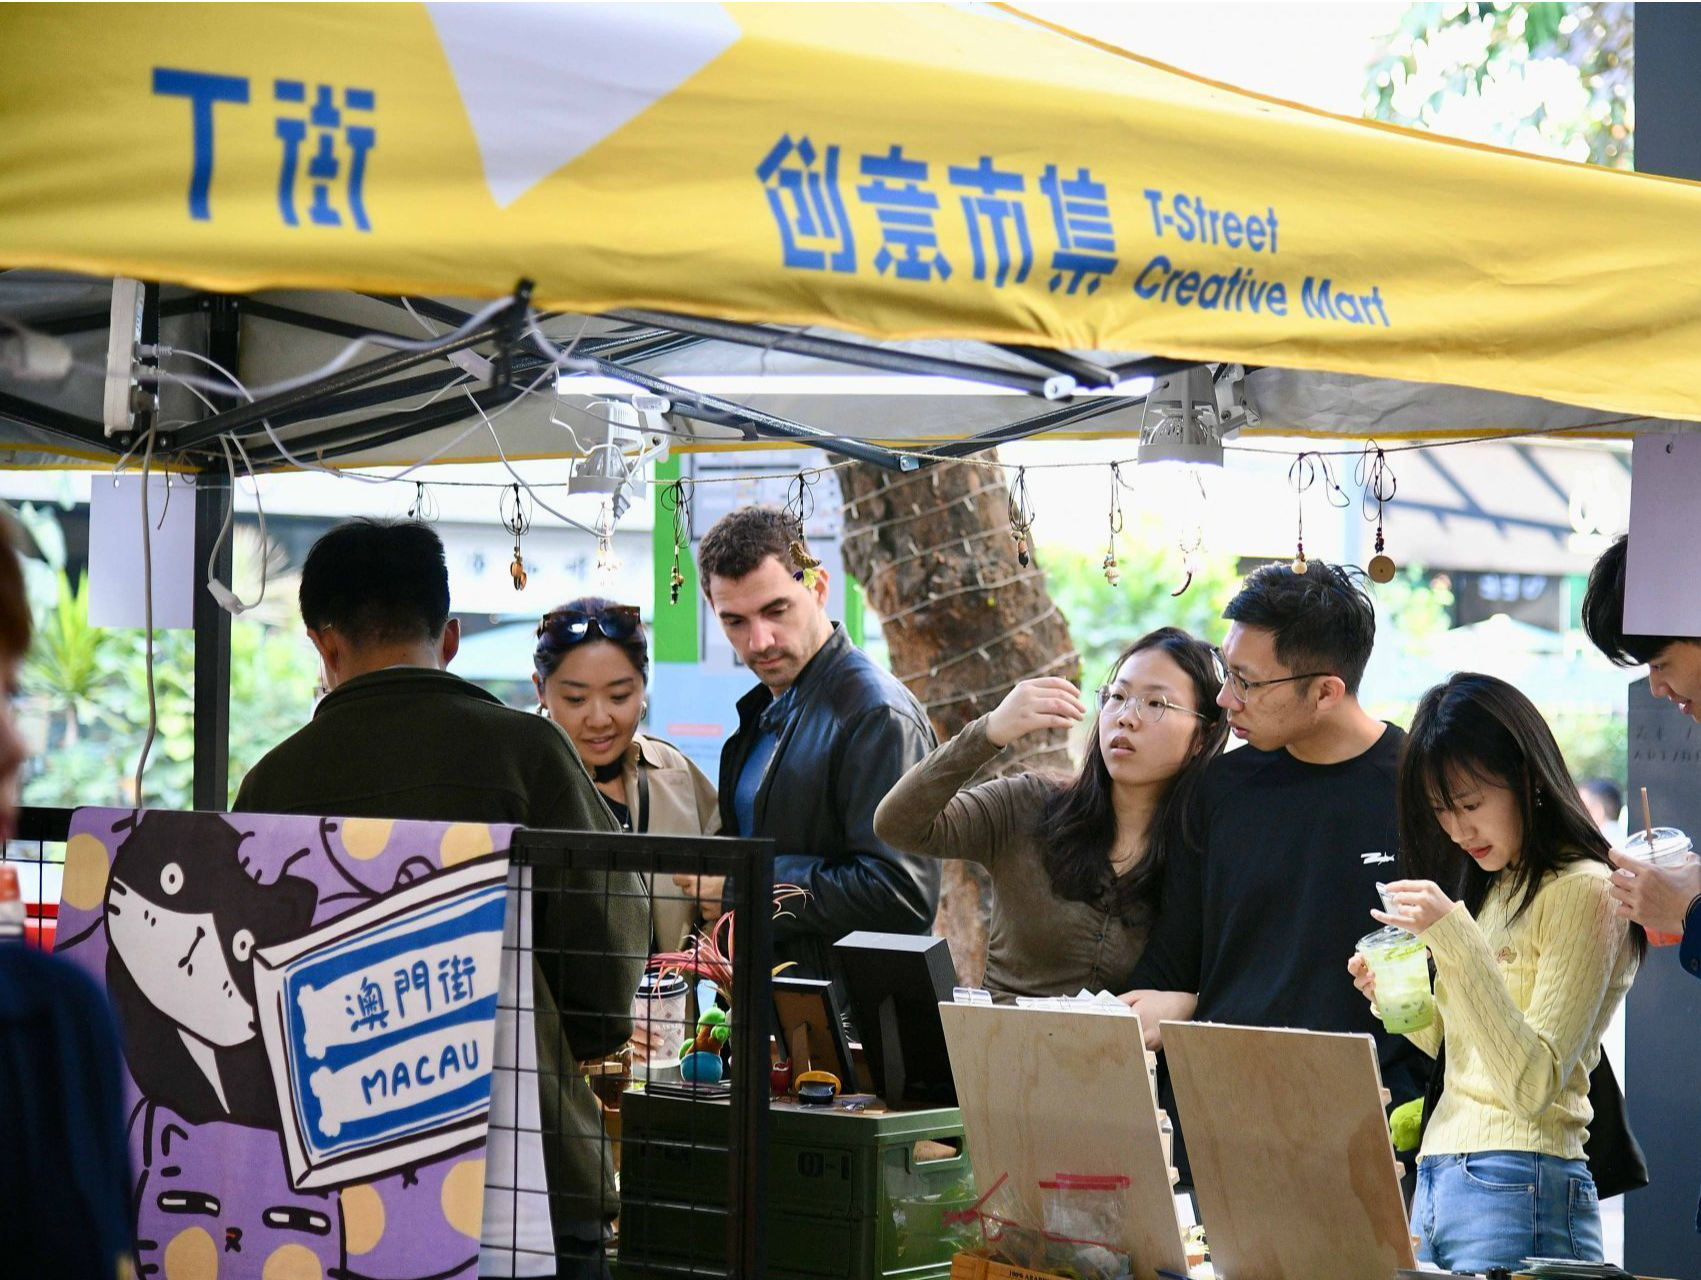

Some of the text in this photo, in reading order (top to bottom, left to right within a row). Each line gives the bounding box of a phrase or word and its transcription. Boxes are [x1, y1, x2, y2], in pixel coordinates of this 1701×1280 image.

[756, 132, 1119, 297] 创意市集
[1143, 188, 1279, 254] T-Street
[1133, 255, 1391, 327] Creative Mart
[344, 954, 477, 1033] 澳門街
[361, 1039, 479, 1106] MACAU
